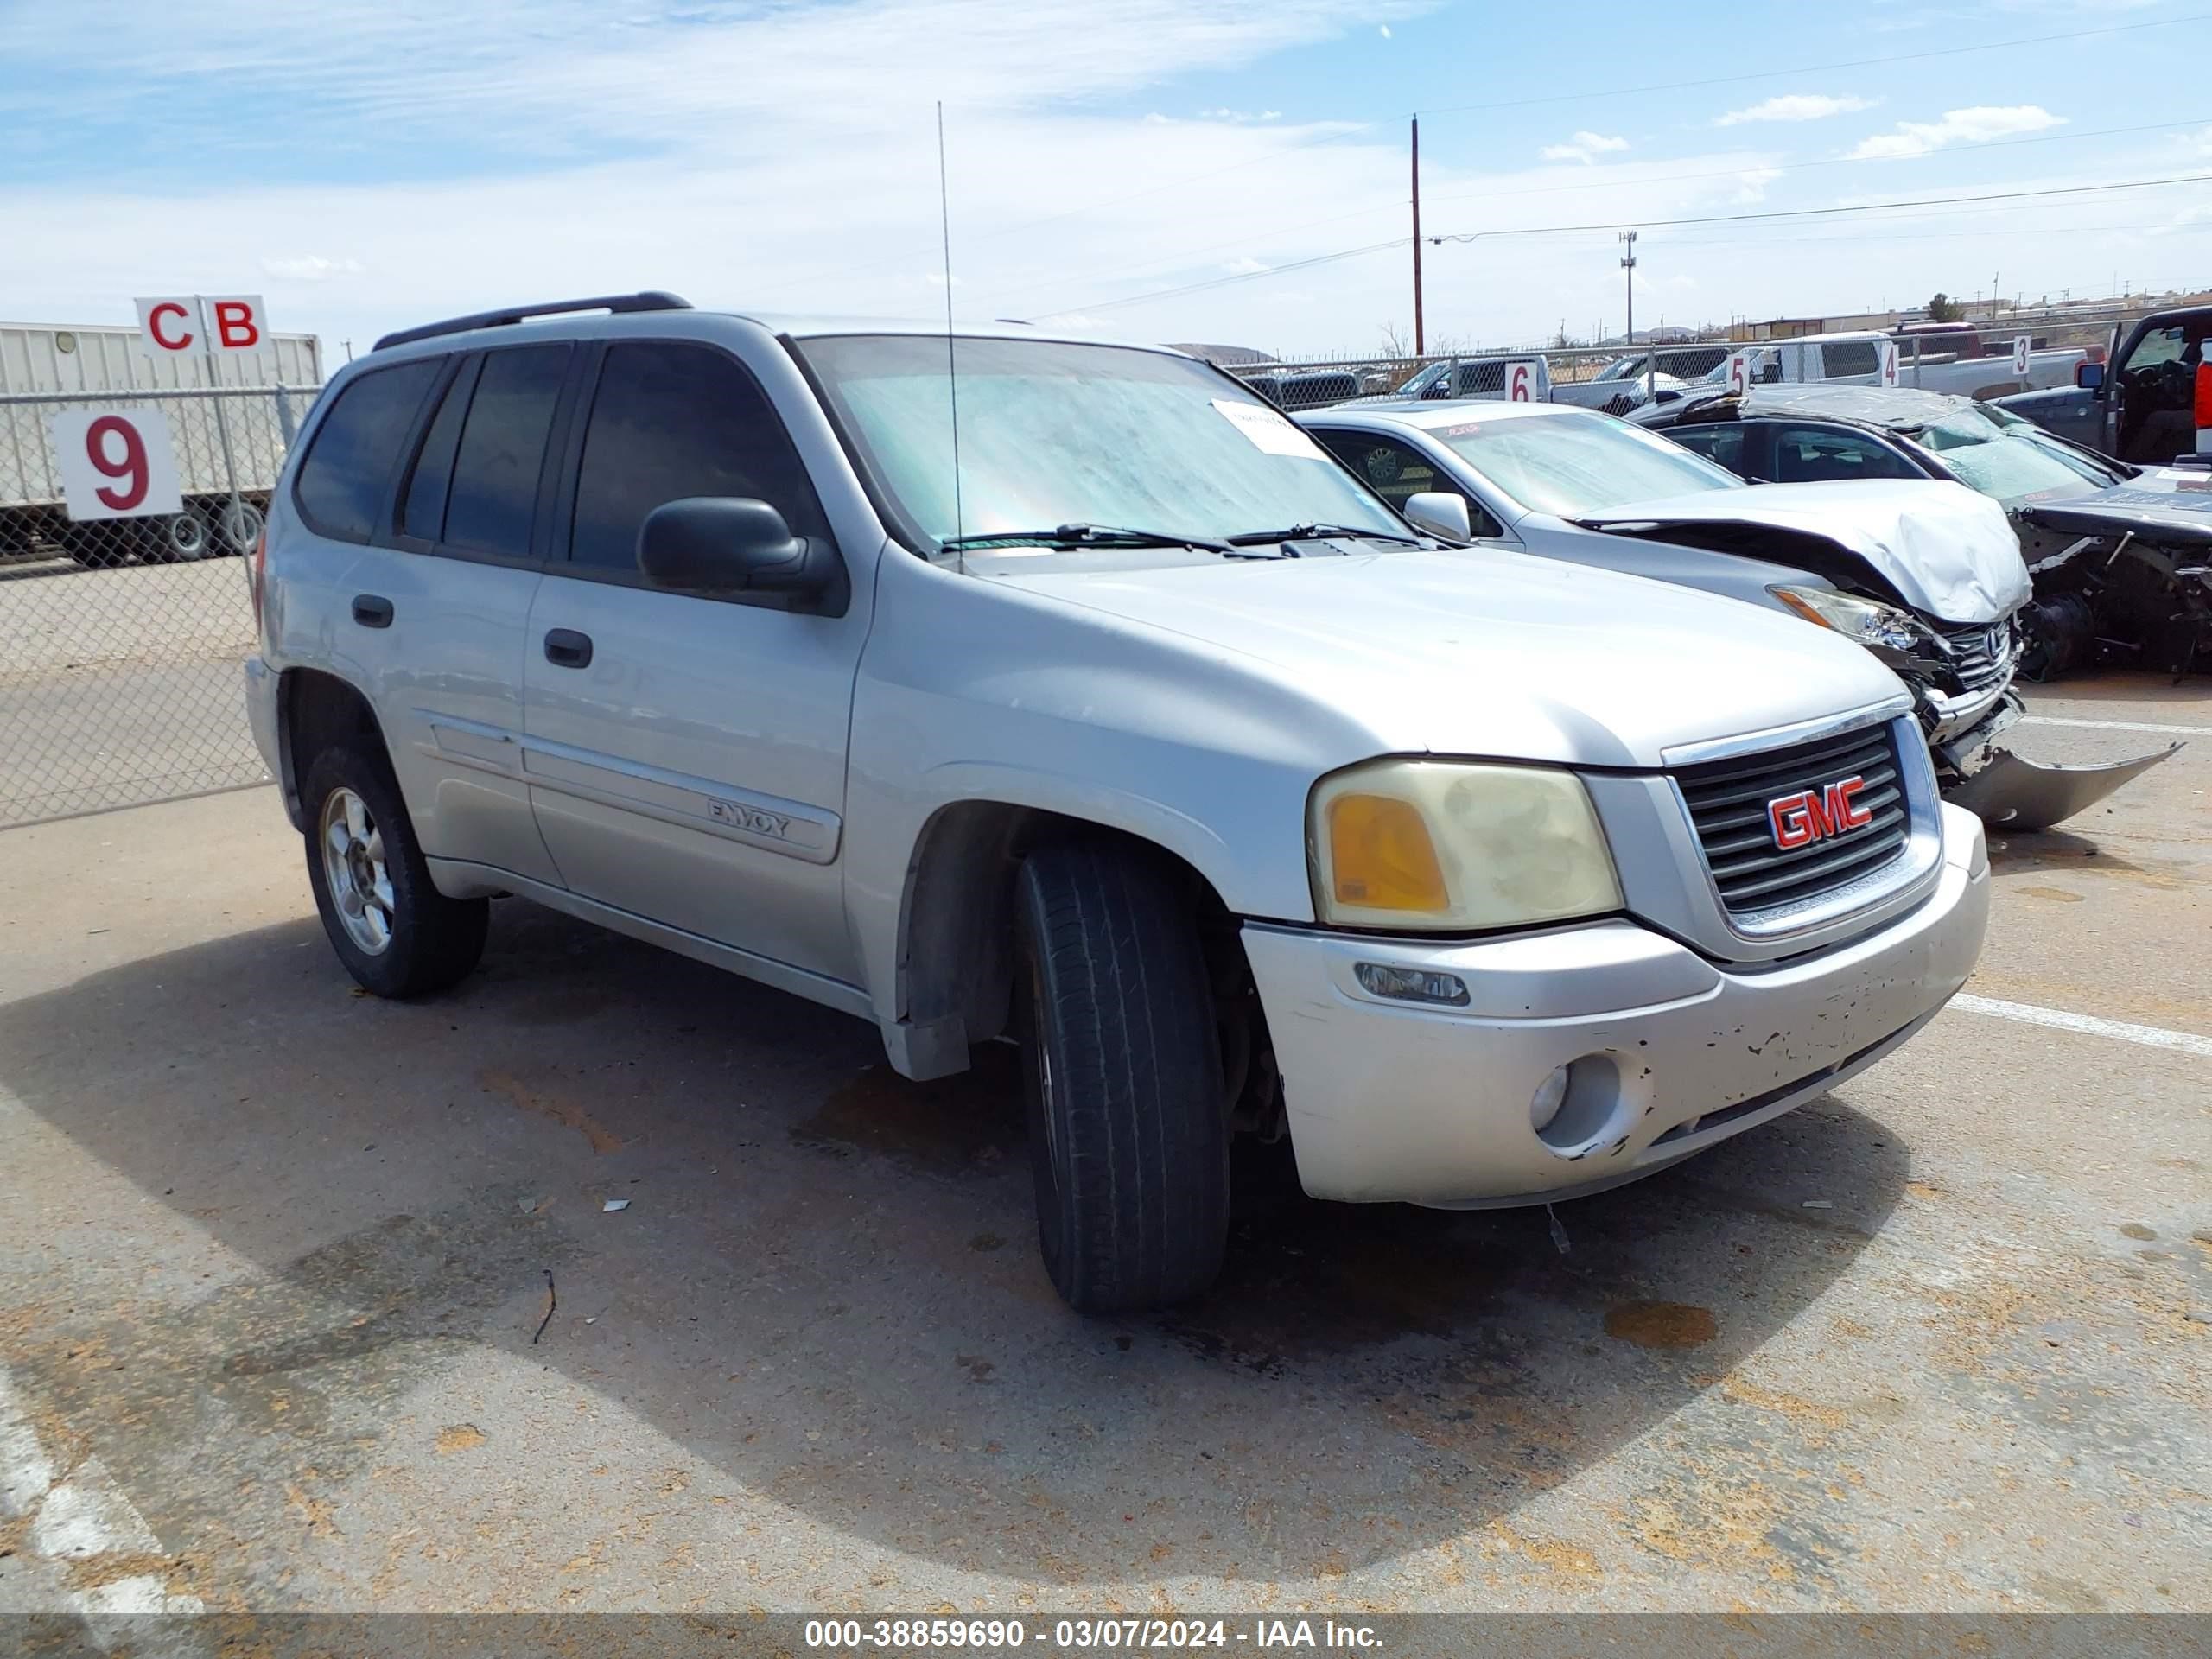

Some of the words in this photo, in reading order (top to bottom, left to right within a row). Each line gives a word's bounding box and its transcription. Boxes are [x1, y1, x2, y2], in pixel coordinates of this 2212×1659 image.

[149, 302, 194, 350] C
[214, 302, 259, 347] B
[1885, 347, 1895, 385] 4
[2018, 338, 2027, 372] 3
[1512, 366, 1529, 402] 6
[1732, 358, 1744, 395] 5
[86, 416, 149, 511] 9
[707, 798, 790, 837] ENVOY
[1768, 774, 1873, 852] GMC
